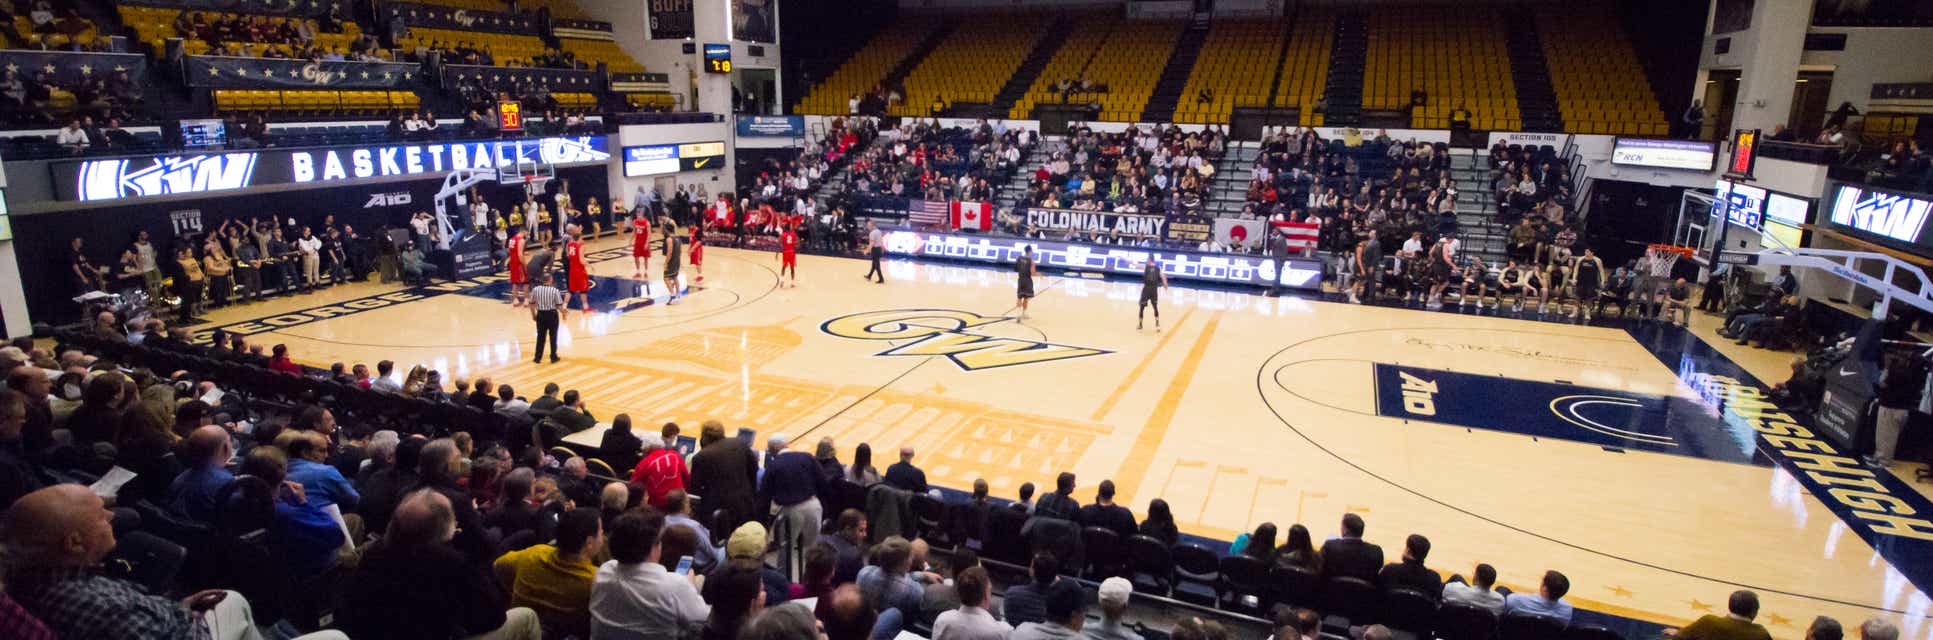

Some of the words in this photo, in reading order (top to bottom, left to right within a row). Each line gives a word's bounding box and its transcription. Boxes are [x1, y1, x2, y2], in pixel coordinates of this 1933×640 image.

[503, 112, 517, 127] 30
[291, 140, 532, 183] BASKETBALL
[172, 217, 203, 234] 114
[1027, 209, 1110, 232] COLONIAL
[1115, 215, 1166, 236] ARMY
[819, 307, 1117, 372] GW
